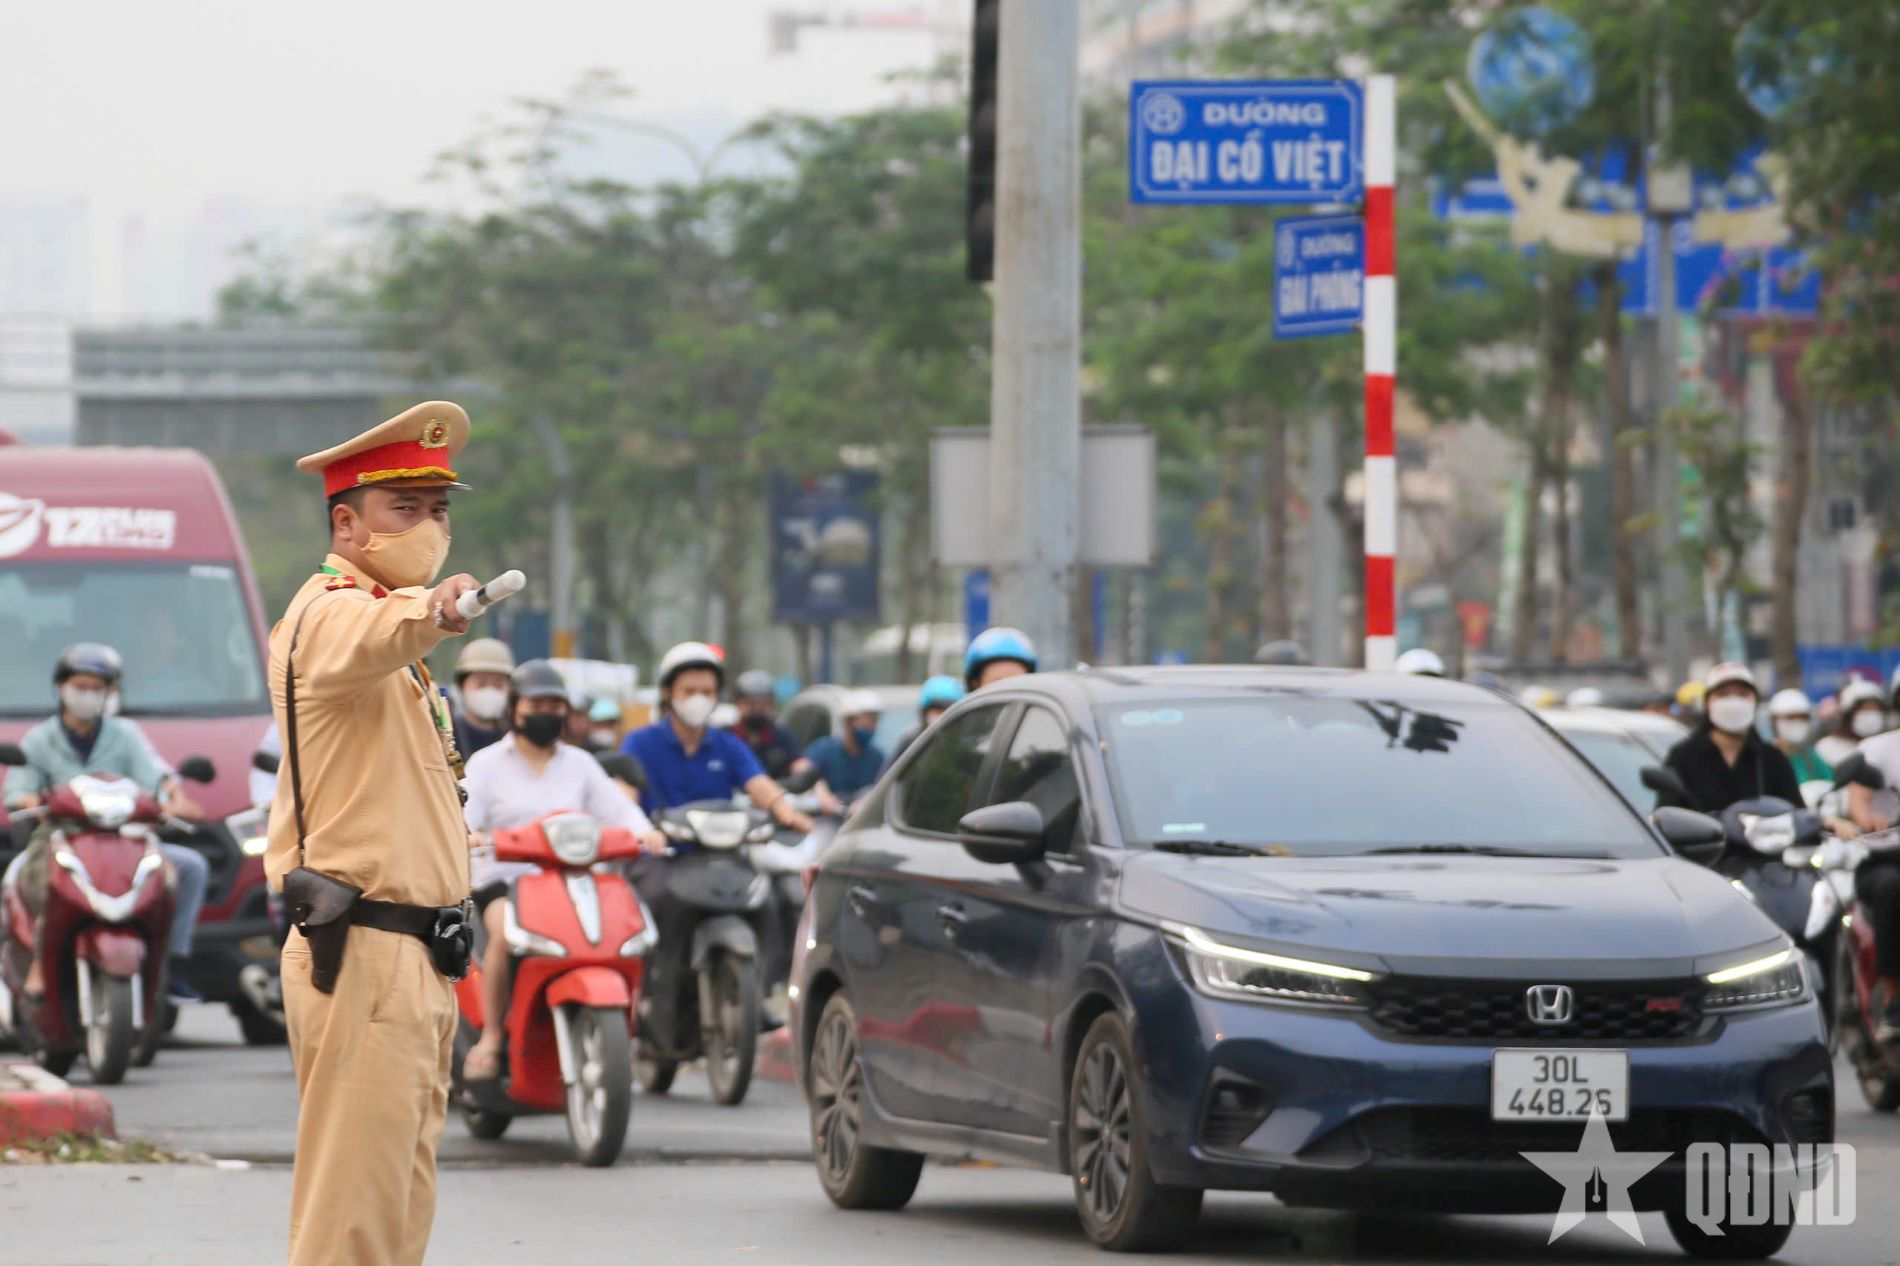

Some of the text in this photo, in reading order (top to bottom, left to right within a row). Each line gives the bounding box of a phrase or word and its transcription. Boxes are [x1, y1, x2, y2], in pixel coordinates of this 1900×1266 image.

[1272, 132, 1344, 191] VIỆT
[1533, 1055, 1588, 1083] 30L
[1508, 1088, 1612, 1116] 448.26
